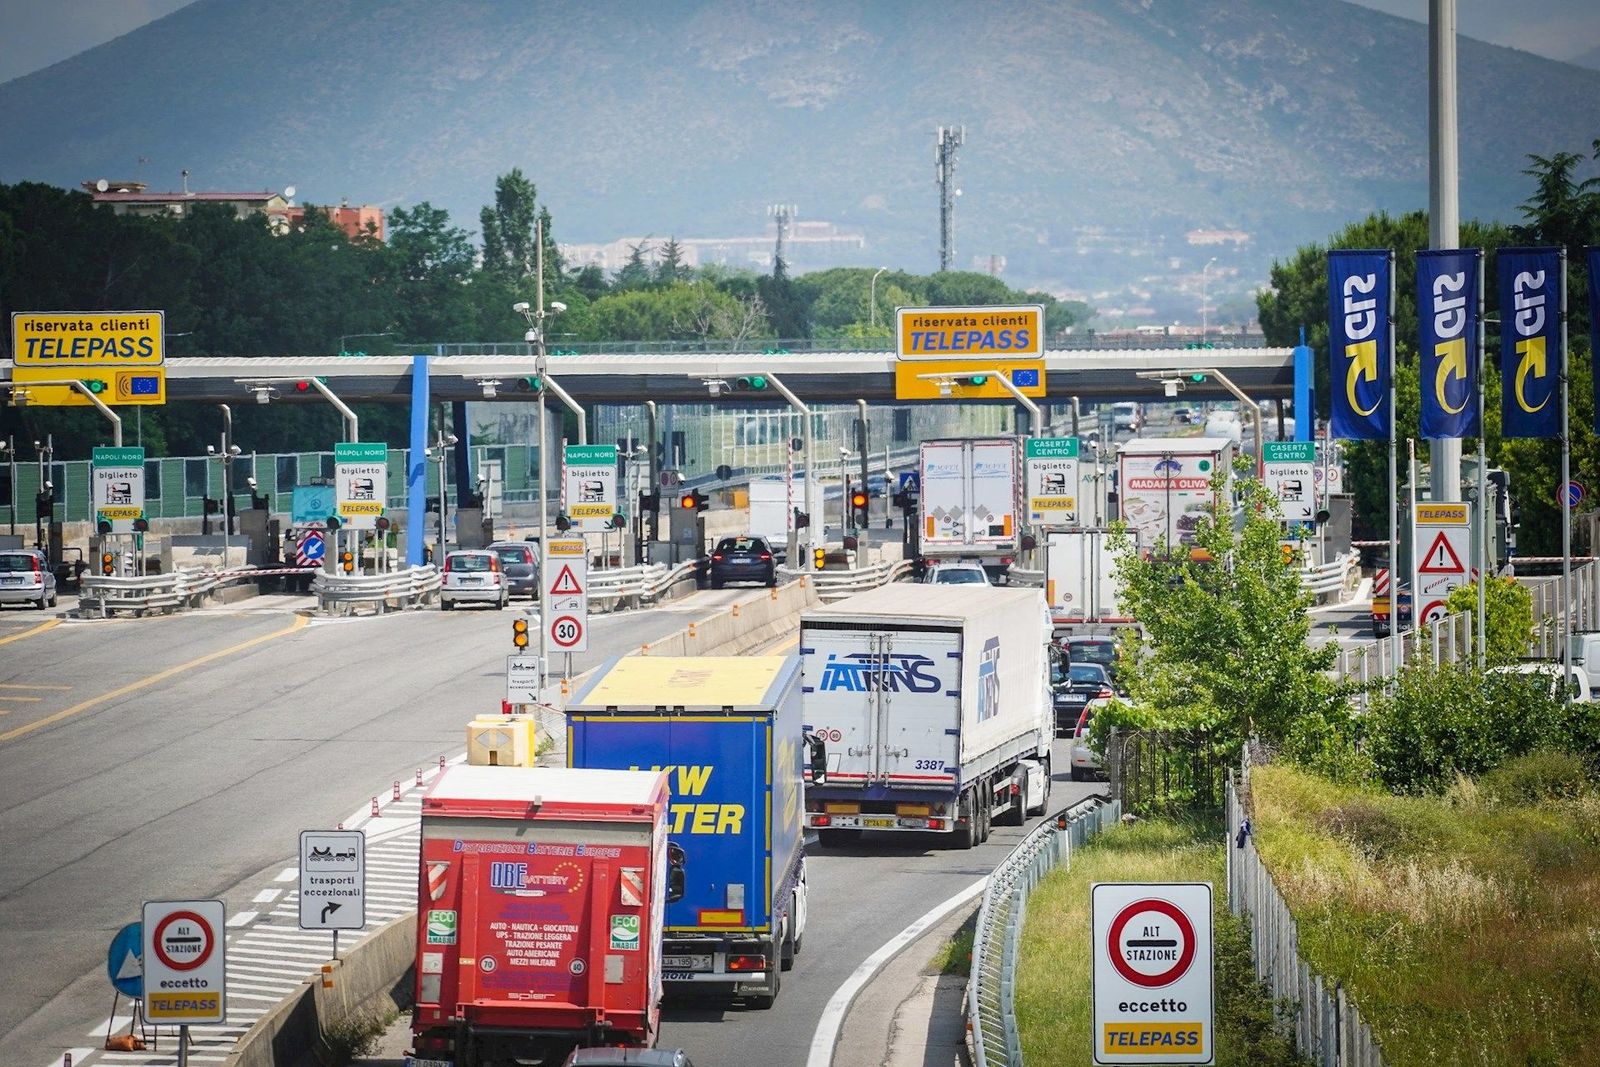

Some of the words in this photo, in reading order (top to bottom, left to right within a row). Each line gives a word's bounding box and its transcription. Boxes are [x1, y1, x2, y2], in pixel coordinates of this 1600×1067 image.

[24, 320, 93, 332] riservata
[100, 318, 150, 331] clienti
[912, 316, 977, 327] riservata
[982, 315, 1028, 326] clienti
[910, 329, 1030, 350] TELEPASS
[25, 336, 154, 358] TELEPASS
[1180, 479, 1206, 488] OLIVA
[558, 624, 575, 638] 30
[915, 760, 945, 770] 3387
[310, 876, 355, 886] trasporti
[304, 888, 360, 897] eccezionali
[177, 926, 190, 935] ALT
[512, 923, 538, 931] NAUTICA
[543, 924, 578, 933] GIOCATTOLI
[1142, 926, 1160, 937] ALT
[514, 932, 542, 940] TRAZIONE
[166, 944, 202, 954] STAZIONE
[524, 950, 560, 958] AMERICANE
[1126, 950, 1177, 961] STAZIONE
[160, 977, 208, 988] eccetto
[151, 998, 217, 1011] TELEPASS
[1118, 998, 1188, 1012] eccetto
[1107, 1031, 1198, 1046] TELEPASS
